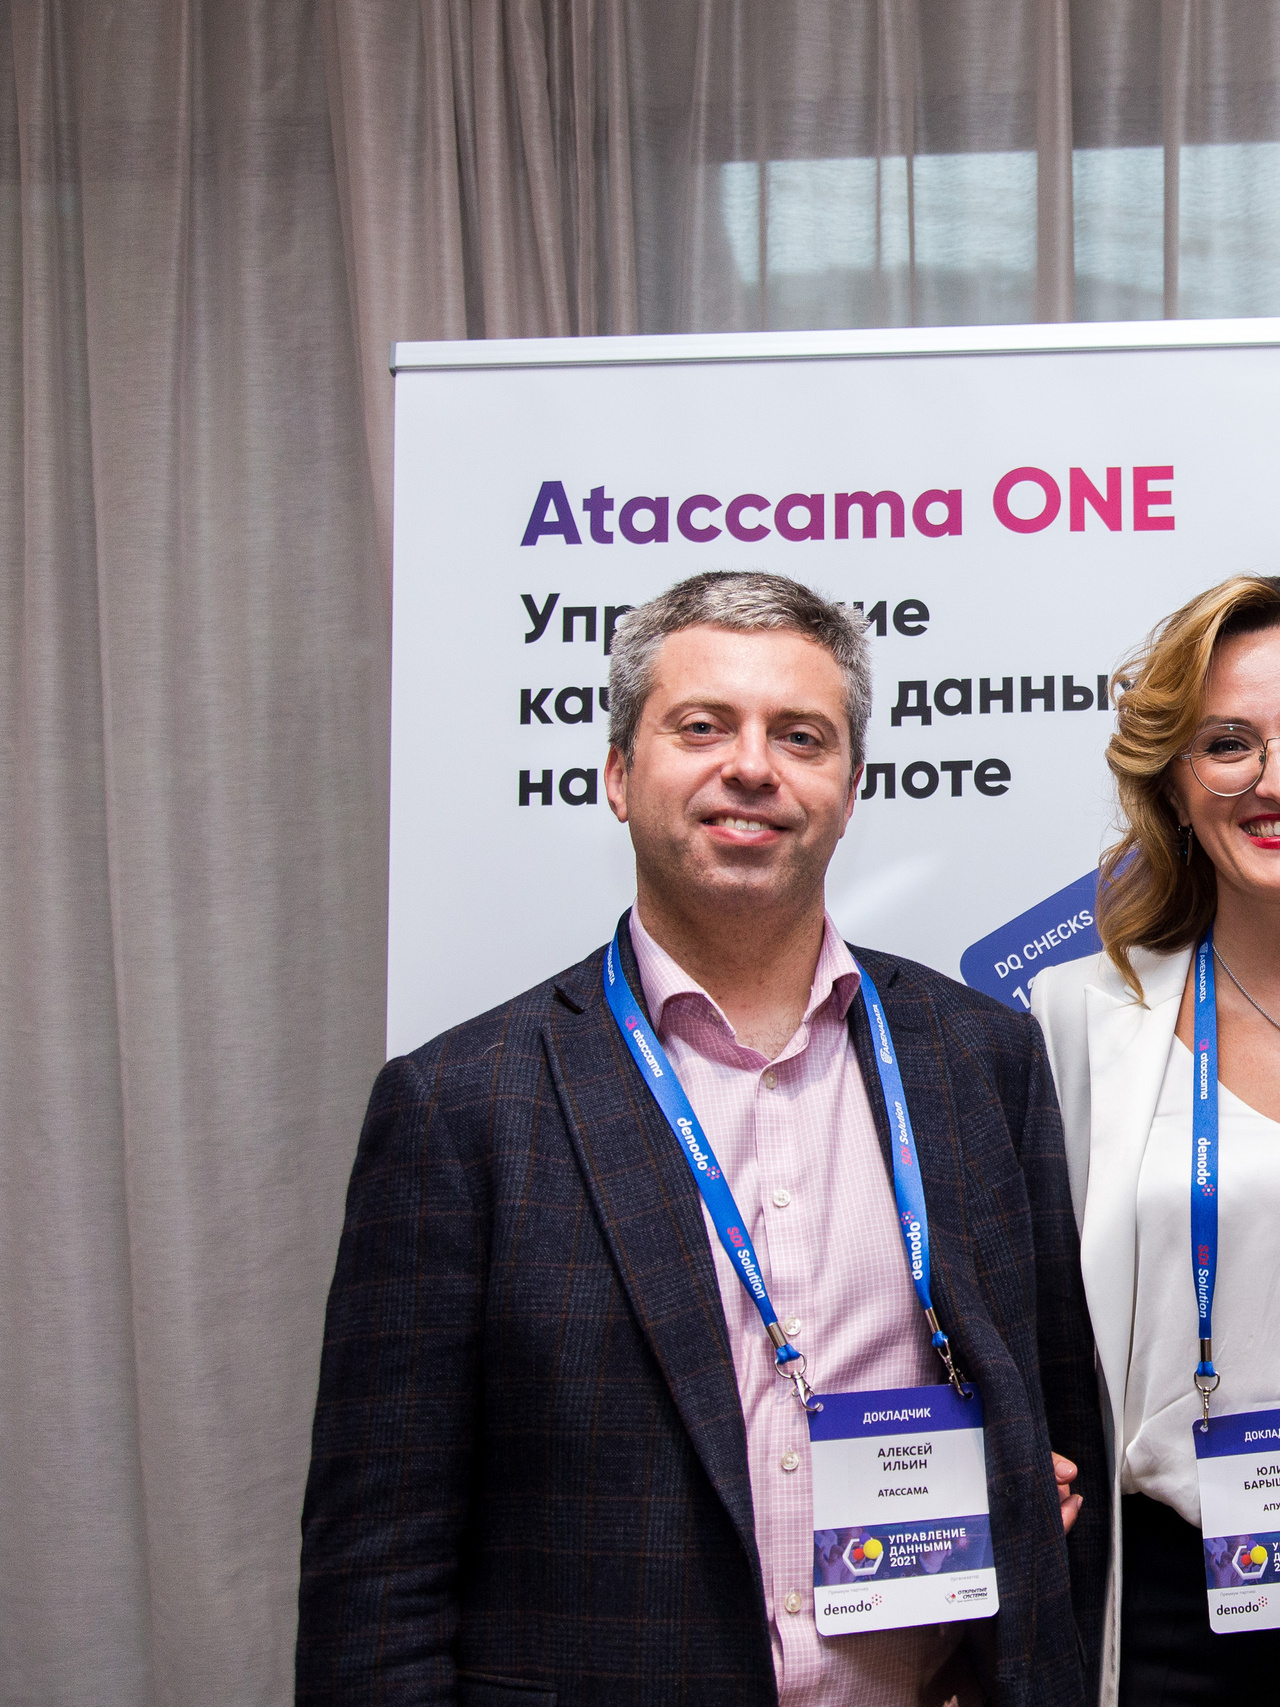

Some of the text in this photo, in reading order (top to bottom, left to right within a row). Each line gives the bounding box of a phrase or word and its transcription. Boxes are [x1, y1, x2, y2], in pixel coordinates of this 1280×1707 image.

[519, 465, 1175, 546] Ataccama ONE
[891, 674, 1132, 727] данны
[994, 910, 1094, 979] DQ CHECKS
[1012, 977, 1035, 1009] 1
[872, 1004, 890, 1055] ARENADATA
[632, 1029, 664, 1079] ataccama
[1200, 1052, 1208, 1100] ataccama
[677, 1117, 708, 1171] denodo
[895, 1101, 913, 1166] SDI Solution
[1197, 1138, 1211, 1185] denodo
[727, 1226, 766, 1299] SDI Solution
[907, 1221, 922, 1280] denodo
[1198, 1244, 1209, 1318] SDI Solution
[863, 1408, 931, 1425] ДОКЛАДЧИК
[877, 1442, 933, 1458] АЛЕКСЕЙ
[883, 1459, 928, 1471] ИЛЬИН
[888, 1528, 966, 1545] УПРАВЛЕНИЕ
[889, 1541, 952, 1557] ДАННЫМИ
[890, 1556, 917, 1567] 2021
[824, 1600, 872, 1616] denodo
[1216, 1601, 1259, 1615] denodo
